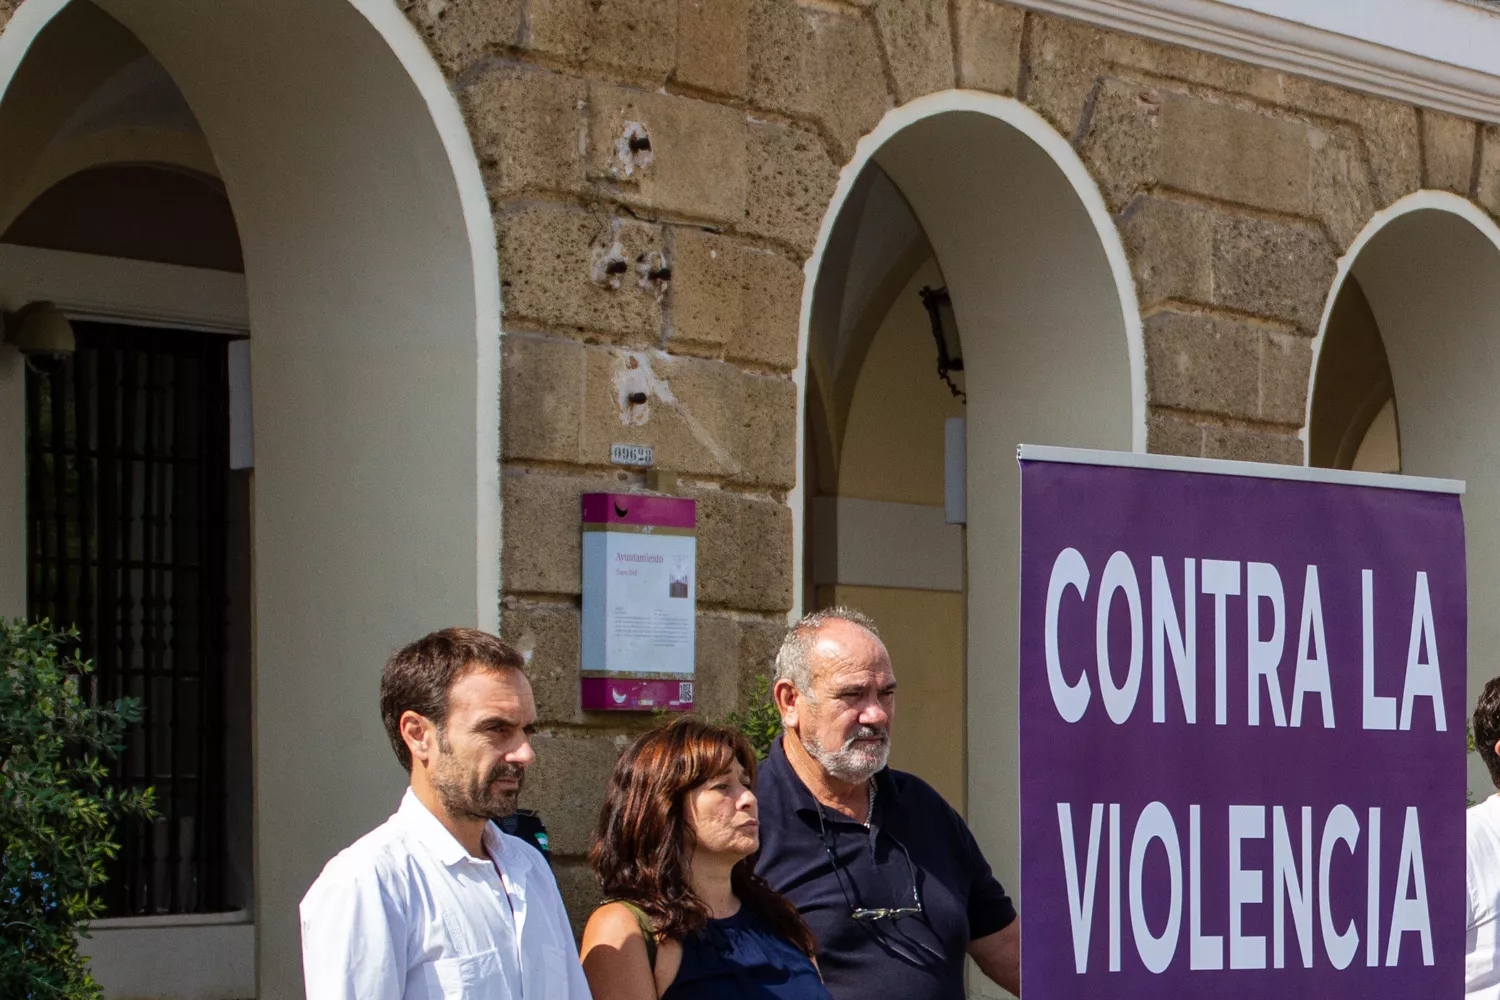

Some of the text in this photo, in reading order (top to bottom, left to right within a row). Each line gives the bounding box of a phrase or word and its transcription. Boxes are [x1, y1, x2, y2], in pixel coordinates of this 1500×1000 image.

[614, 447, 652, 463] 09628
[615, 552, 664, 565] Ayuntamiento
[1044, 547, 1447, 732] CONTRA LA
[1056, 802, 1435, 974] VIOLENCIA
